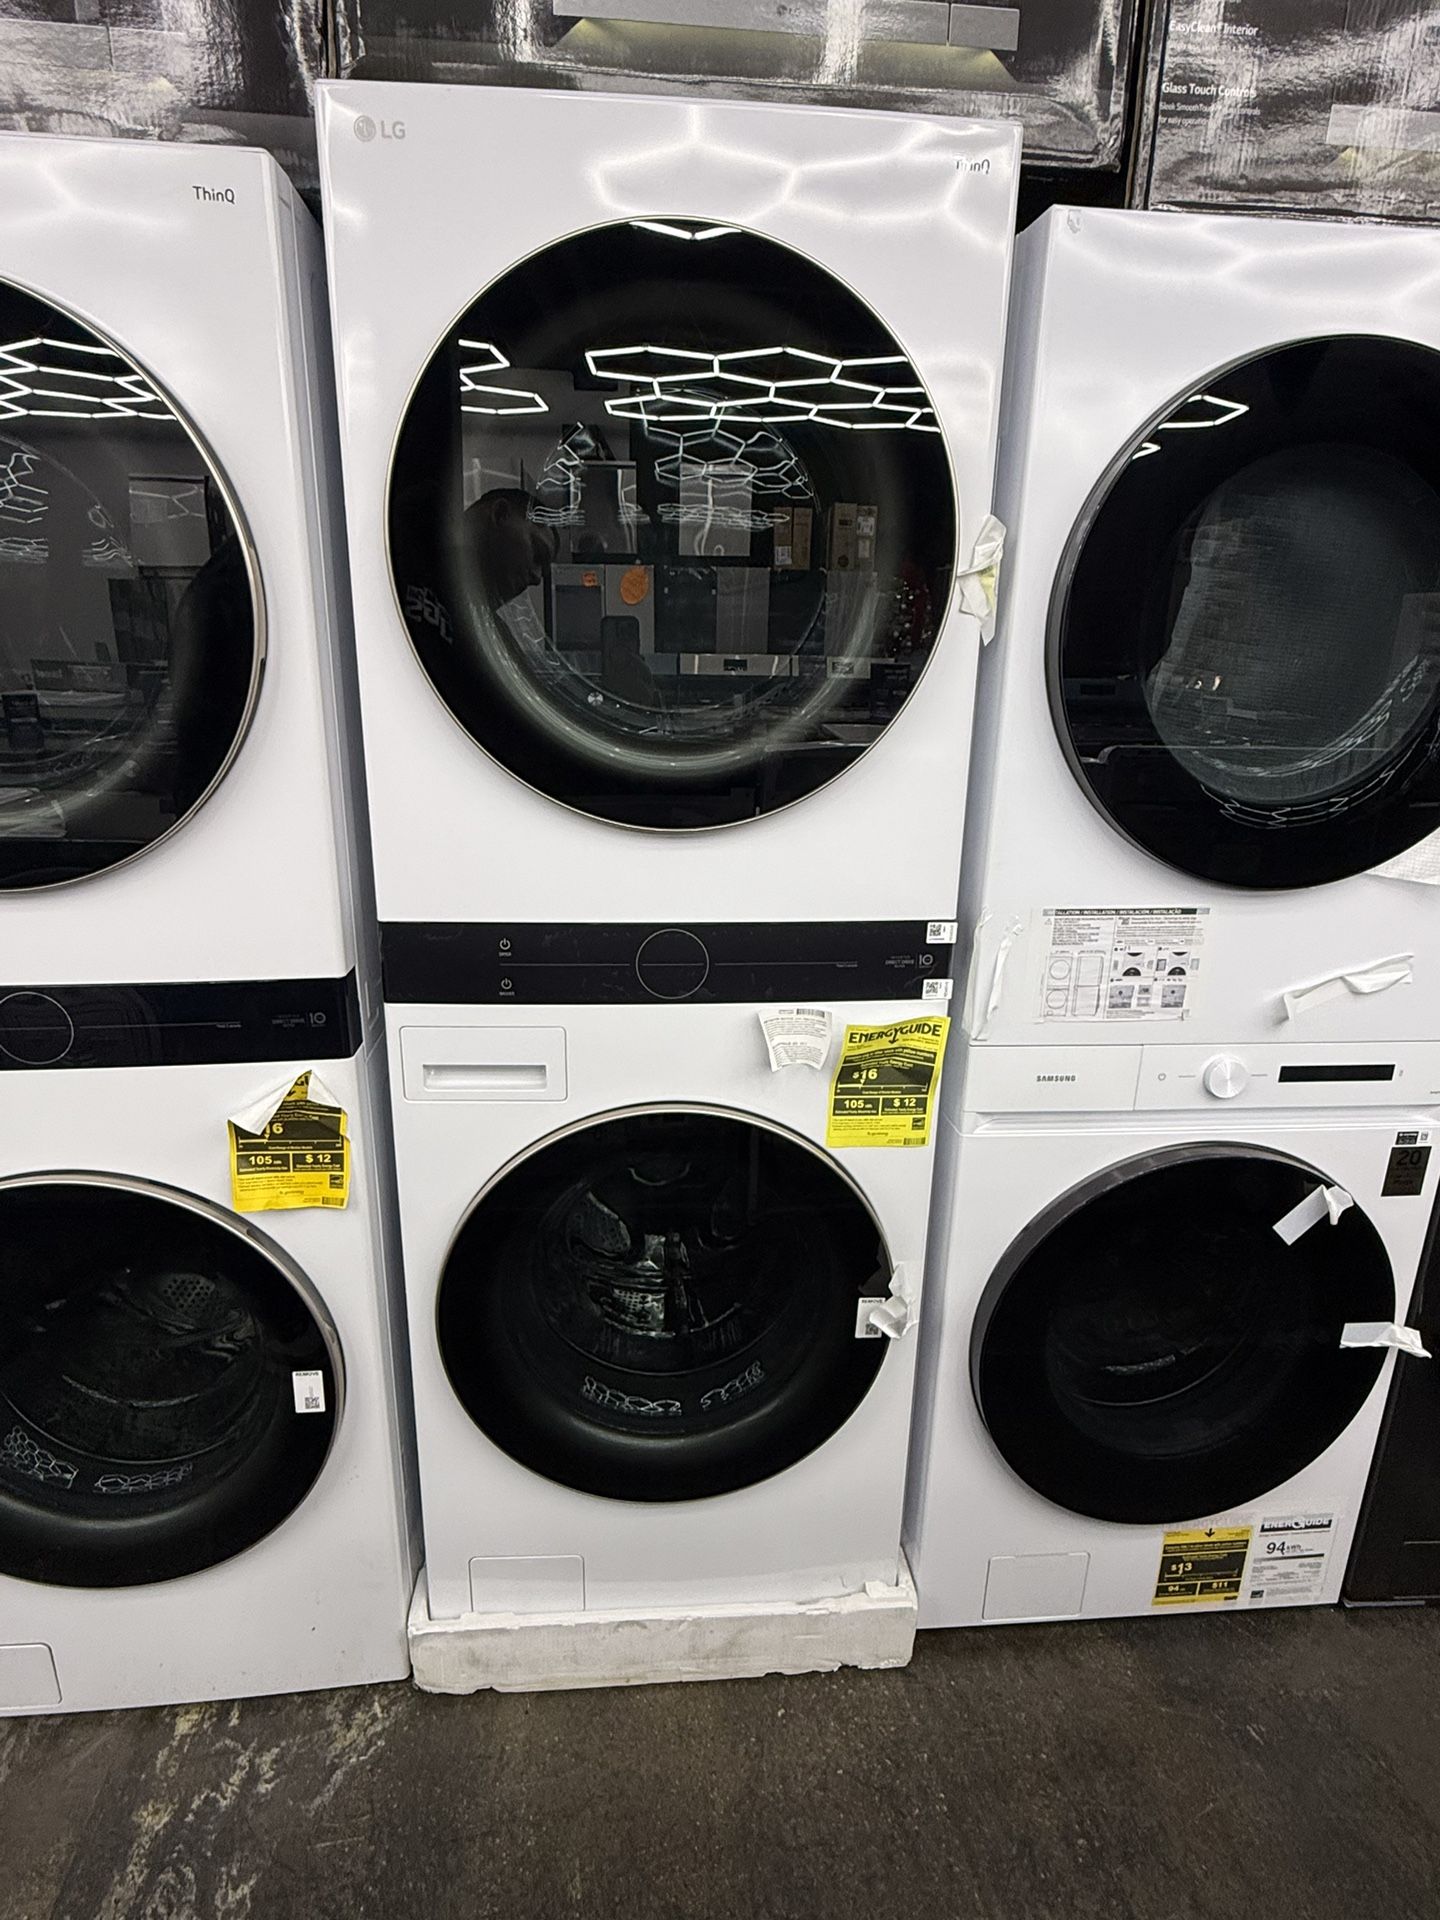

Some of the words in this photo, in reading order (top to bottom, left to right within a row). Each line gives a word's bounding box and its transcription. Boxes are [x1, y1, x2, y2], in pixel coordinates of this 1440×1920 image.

[1223, 23, 1259, 36] Interior
[1162, 82, 1187, 94] Glass
[1189, 84, 1217, 96] Touch
[1218, 85, 1257, 98] Controls
[381, 120, 406, 140] LG
[192, 185, 235, 205] ThinQ
[853, 1069, 878, 1080] $16
[844, 1100, 865, 1109] 105
[893, 1098, 901, 1107] $
[904, 1098, 916, 1107] 12
[249, 1155, 273, 1165] 105
[305, 1154, 314, 1164] $
[317, 1153, 332, 1163] 12
[1396, 1149, 1422, 1165] 20
[1266, 1541, 1286, 1556] 94
[1171, 1562, 1193, 1574] $13
